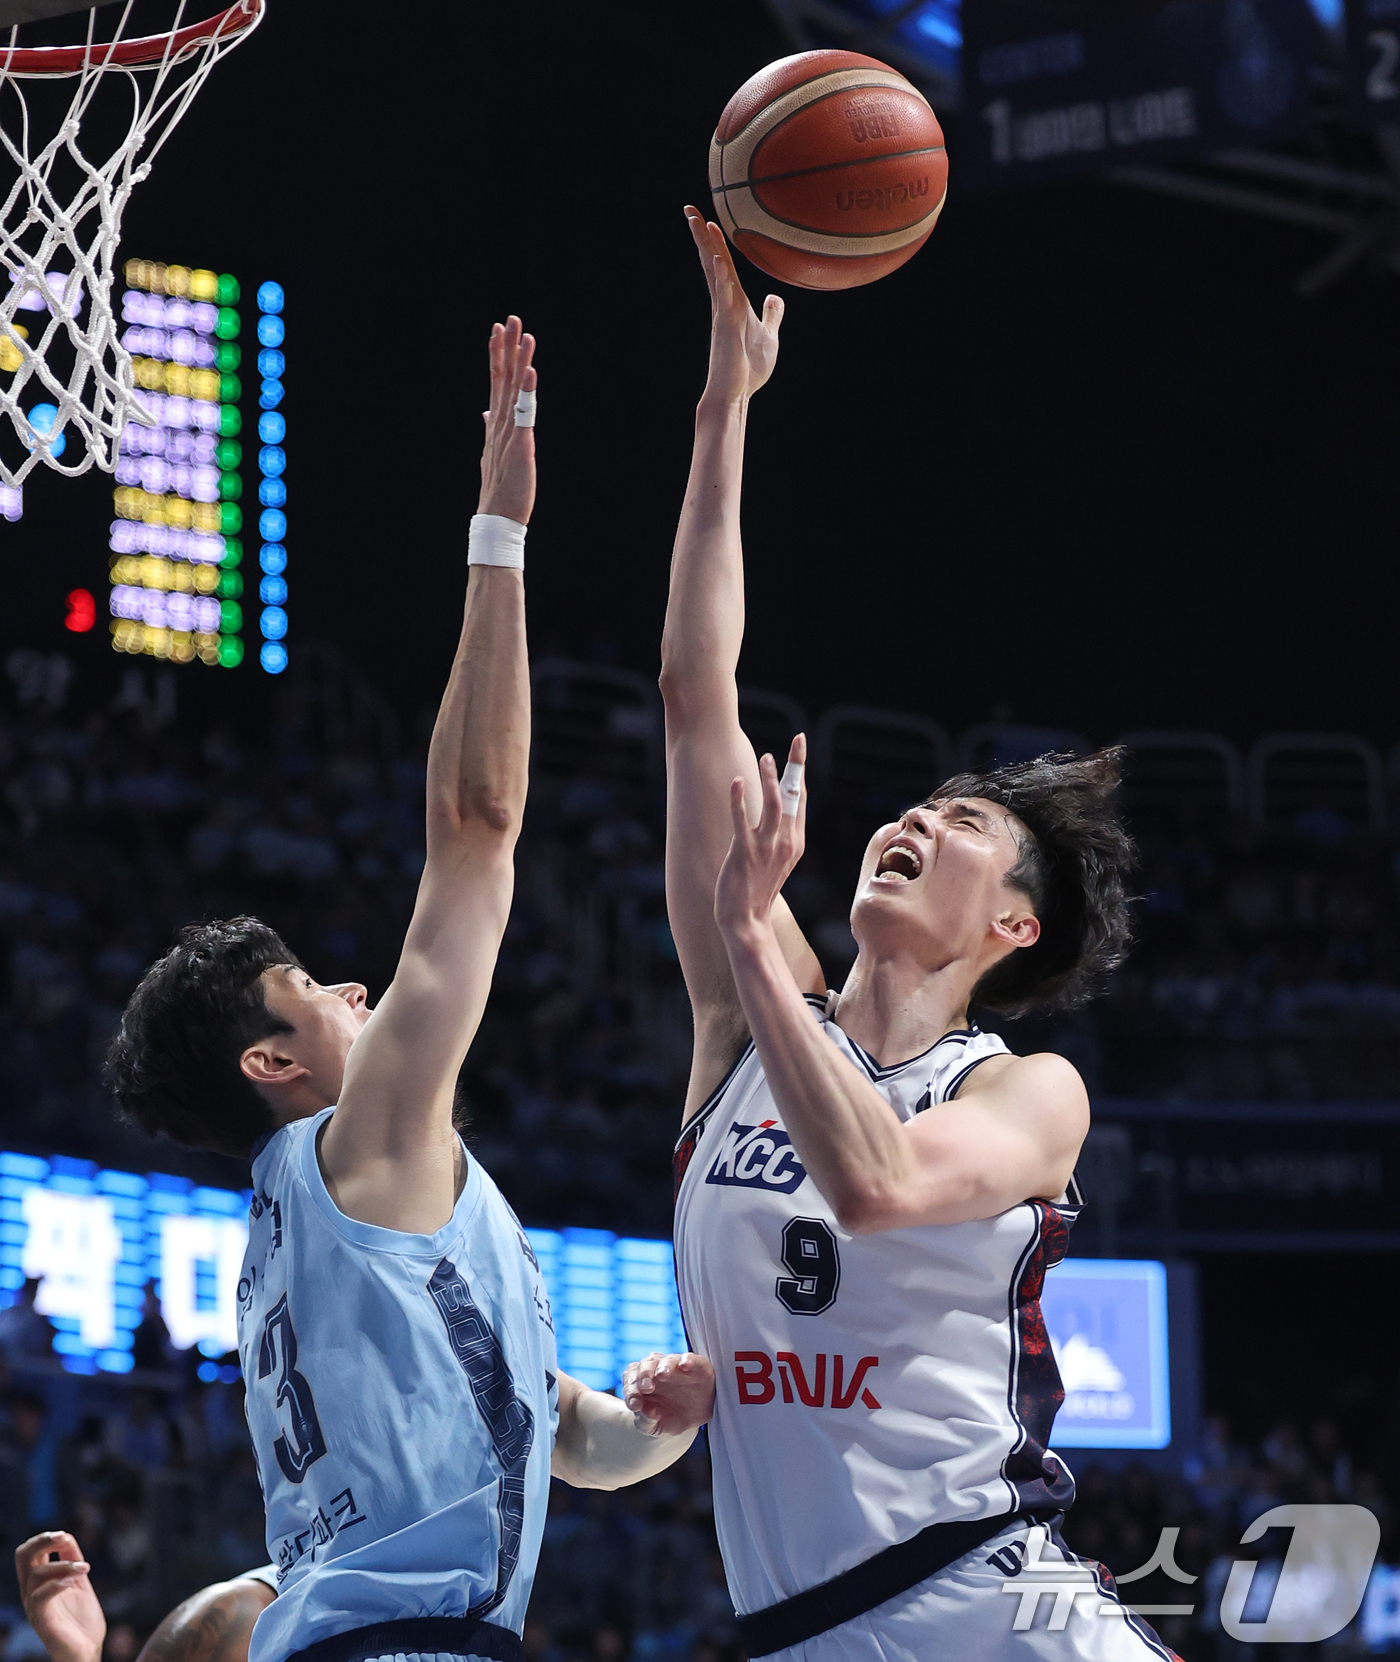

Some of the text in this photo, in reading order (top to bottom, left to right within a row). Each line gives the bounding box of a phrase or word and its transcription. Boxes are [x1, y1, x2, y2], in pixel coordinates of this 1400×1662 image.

[835, 177, 929, 211] molten
[713, 1122, 802, 1184] KCC
[775, 1215, 841, 1317] 9
[258, 1291, 327, 1485] 3
[734, 1350, 883, 1410] BNK
